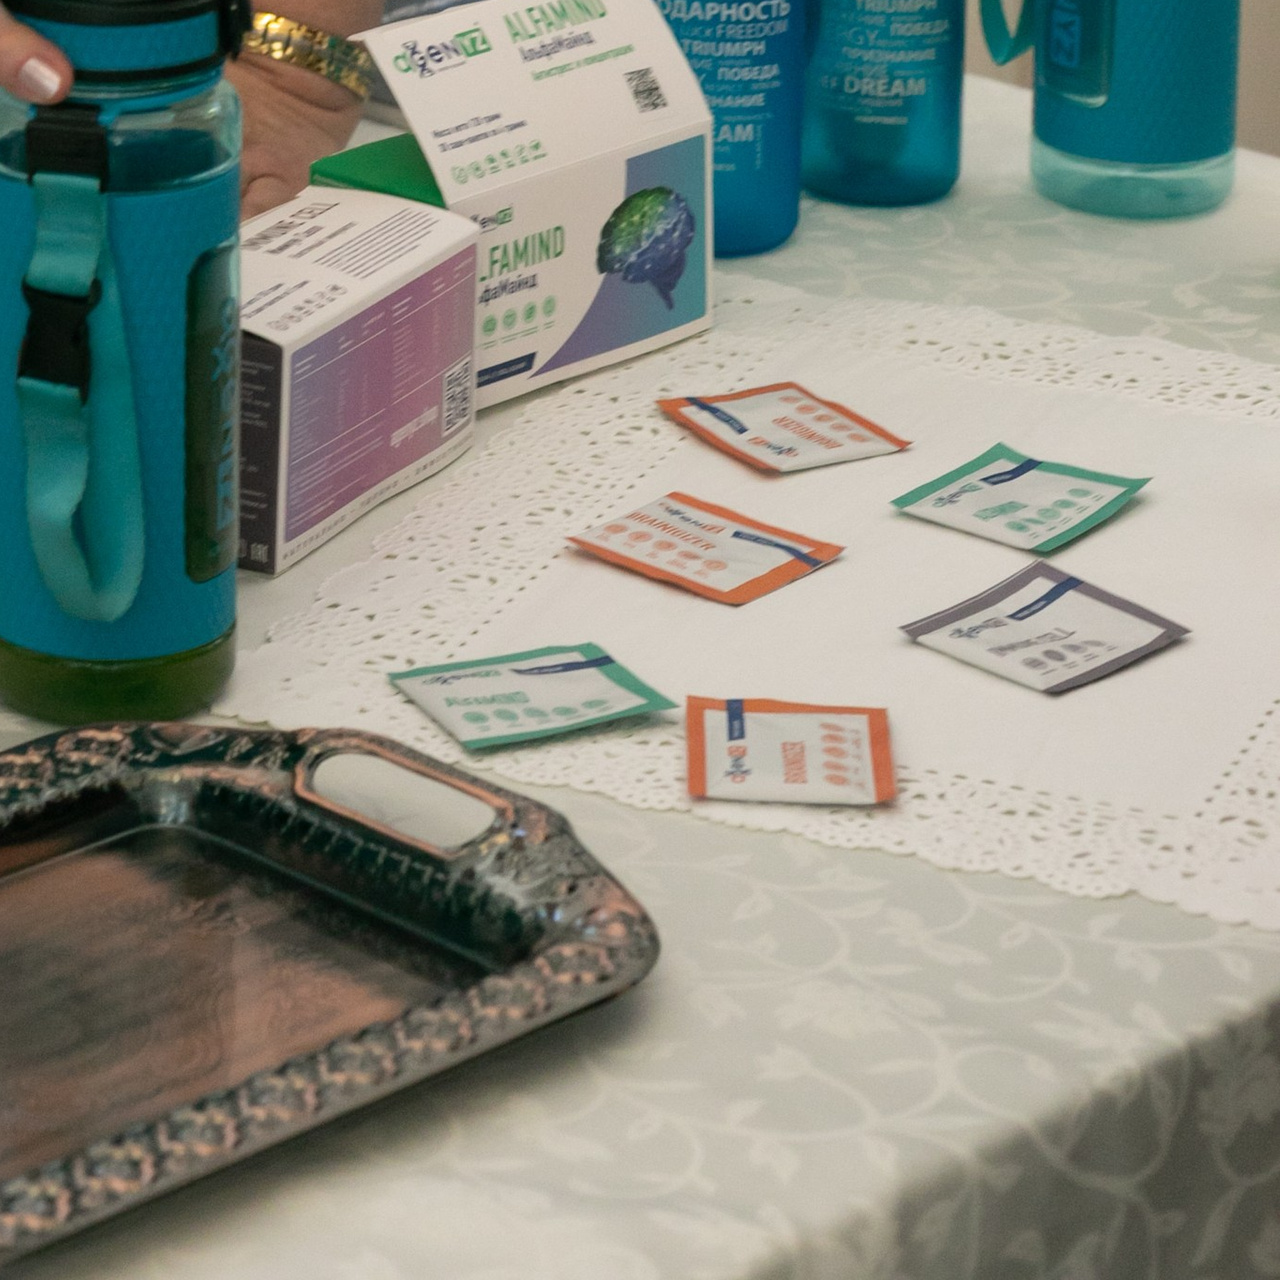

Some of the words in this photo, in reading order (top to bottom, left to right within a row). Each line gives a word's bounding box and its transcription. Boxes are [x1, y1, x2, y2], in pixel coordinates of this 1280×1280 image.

[715, 19, 789, 40] FREEDOM
[680, 39, 766, 57] TRIUMPH
[716, 63, 781, 82] ПОБЕДА
[843, 74, 927, 97] DREAM
[479, 225, 564, 282] FAMIND
